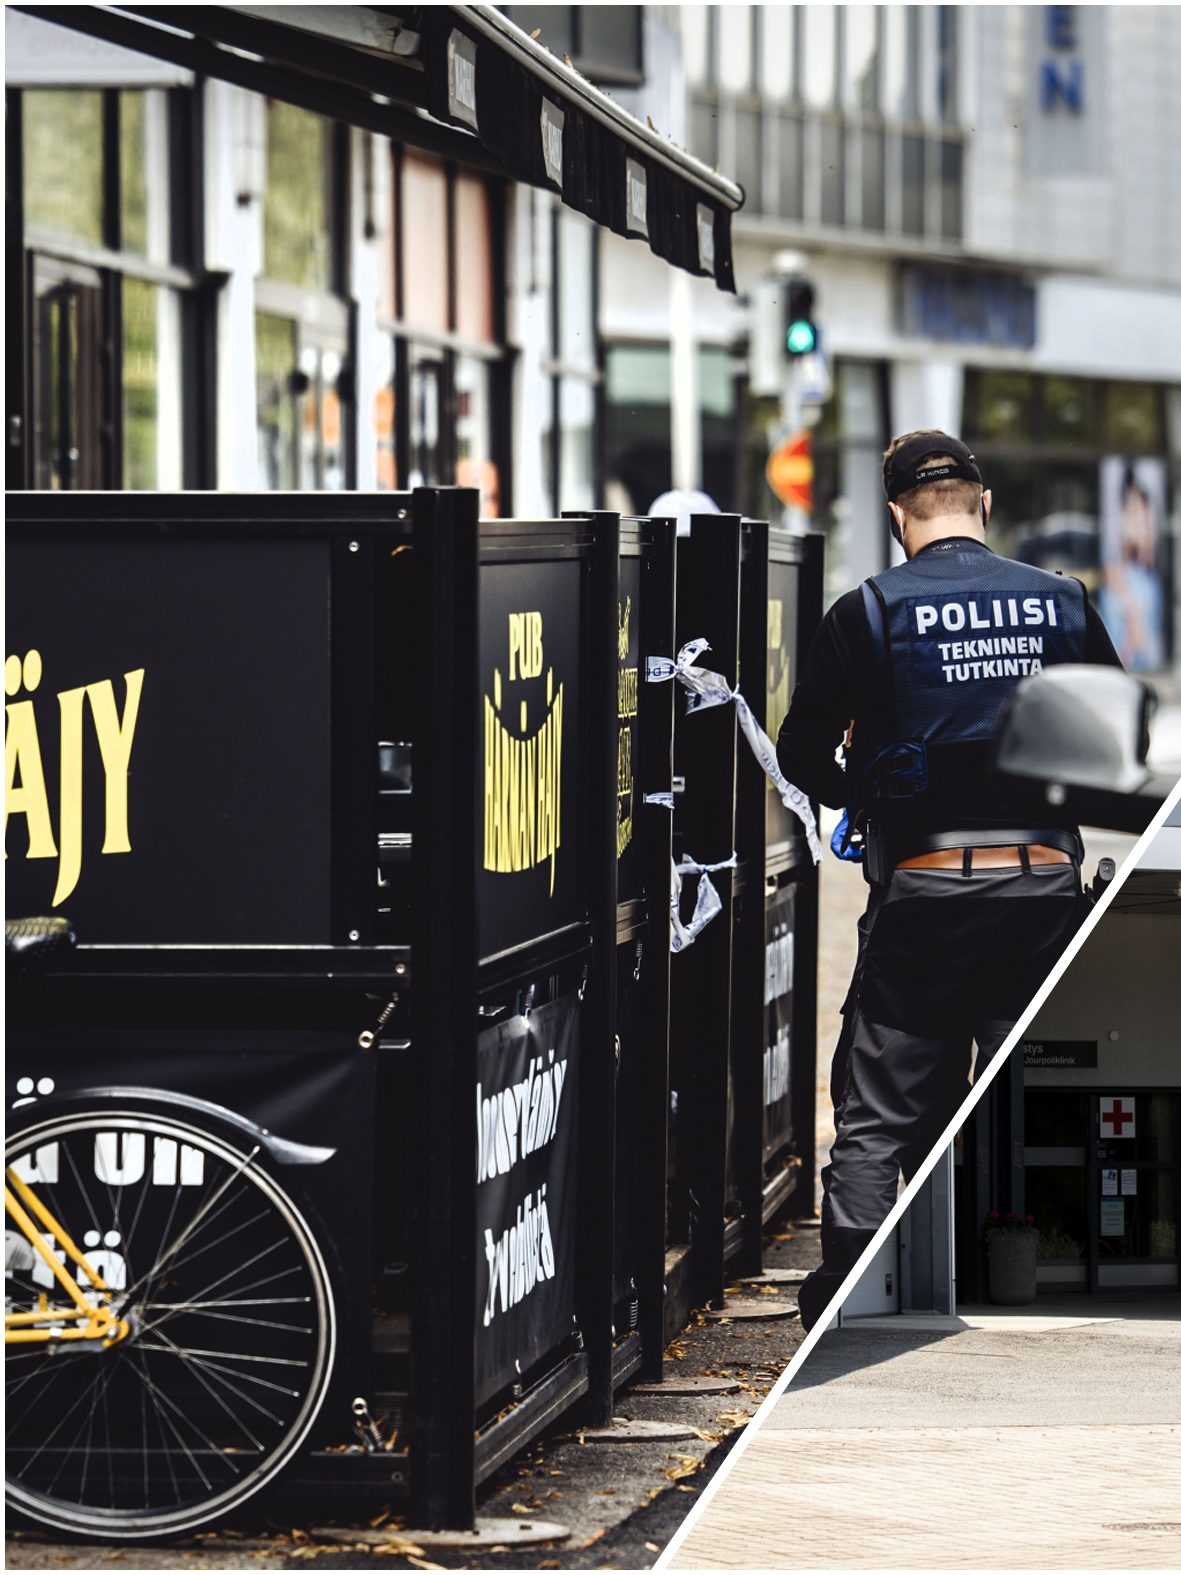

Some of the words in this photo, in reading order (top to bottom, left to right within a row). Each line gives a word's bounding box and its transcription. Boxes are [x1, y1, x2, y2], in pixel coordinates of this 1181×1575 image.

[915, 598, 1058, 634] POLIISI
[508, 611, 543, 681] PUB
[938, 636, 1043, 661] TEKNINEN
[942, 657, 1043, 683] TUTKINTA
